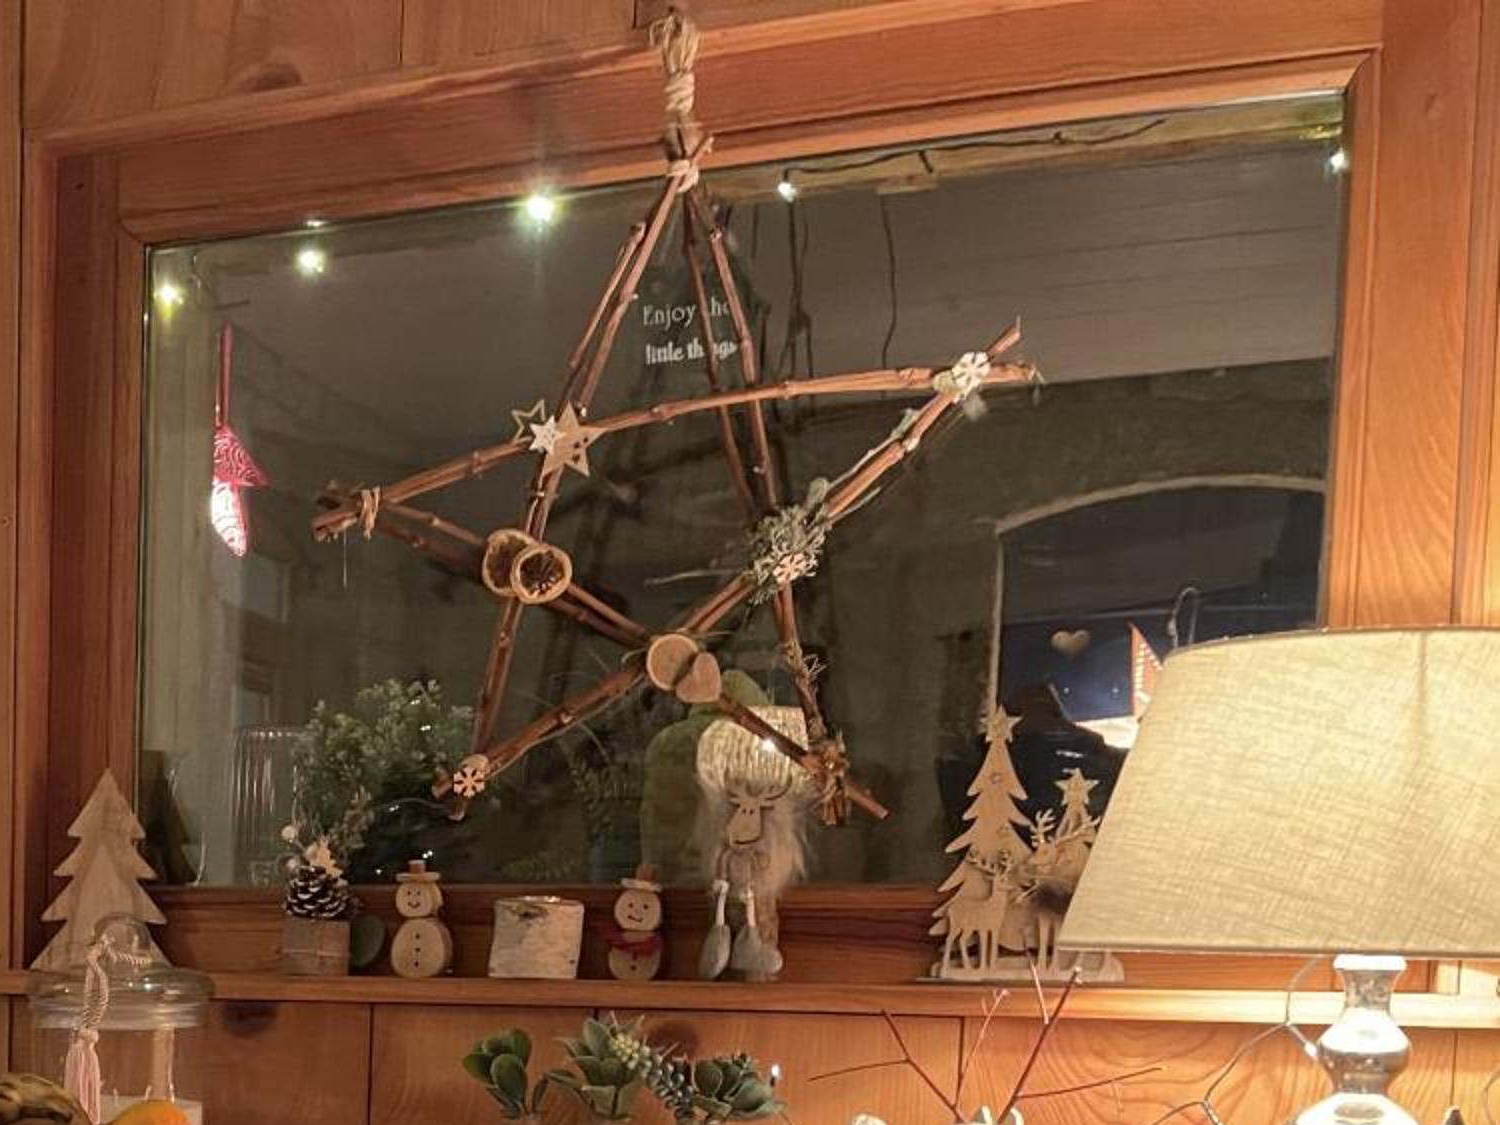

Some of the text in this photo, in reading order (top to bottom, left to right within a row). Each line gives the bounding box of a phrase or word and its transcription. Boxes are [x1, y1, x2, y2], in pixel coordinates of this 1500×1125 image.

[643, 304, 697, 331] Enjoy
[645, 337, 738, 365] little thgs
